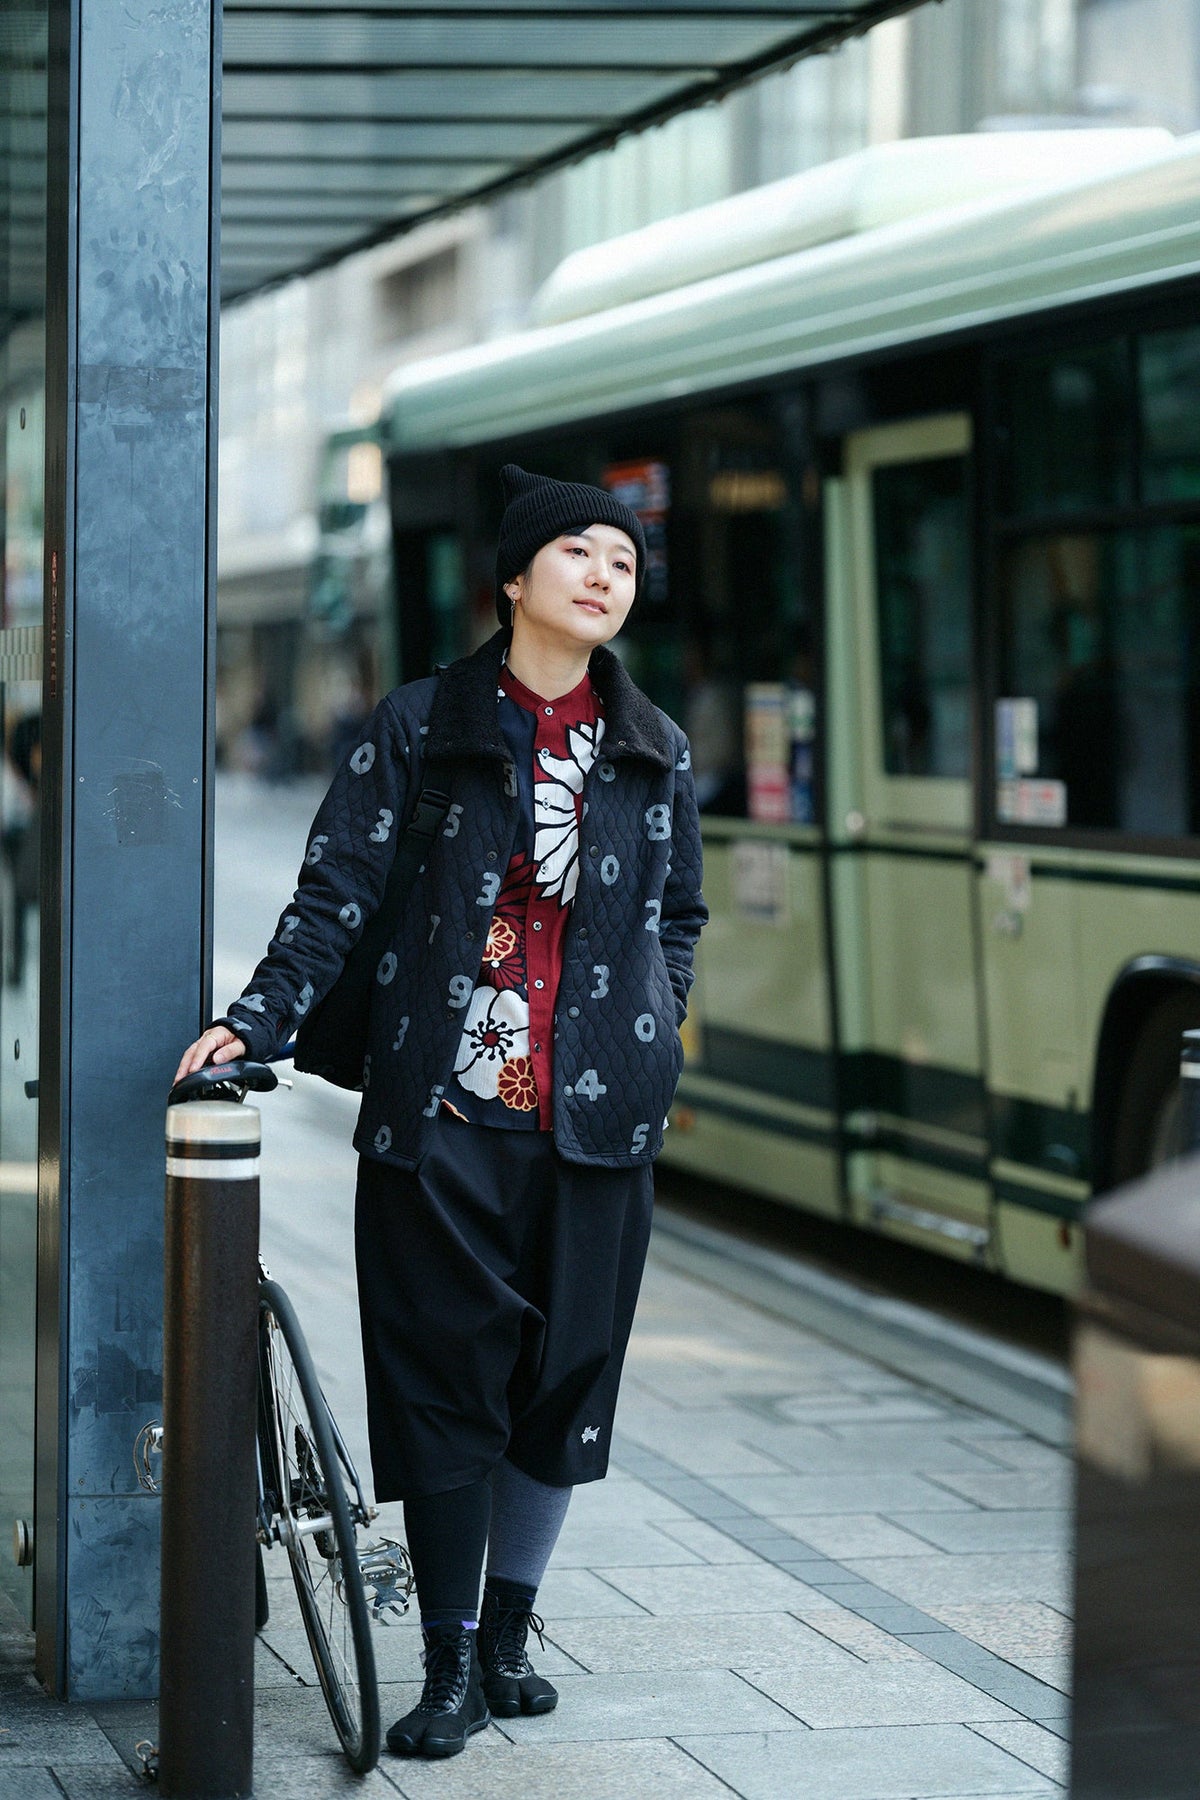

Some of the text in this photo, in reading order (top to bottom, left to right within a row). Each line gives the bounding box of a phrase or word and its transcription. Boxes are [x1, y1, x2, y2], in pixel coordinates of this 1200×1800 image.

[350, 742, 376, 775] 0
[368, 808, 393, 843] 3
[443, 803, 464, 838] 5
[645, 803, 672, 841] 8
[305, 835, 329, 866] 6
[601, 854, 620, 886] 0
[475, 872, 501, 906] 3
[278, 915, 300, 944] 2
[645, 899, 662, 933] 2
[377, 952, 398, 986] 0
[591, 965, 610, 999] 3
[448, 975, 474, 1009] 9
[393, 1016, 410, 1051] 3
[635, 1013, 656, 1043] 0
[574, 1069, 607, 1101] 4
[630, 1123, 650, 1155] 5
